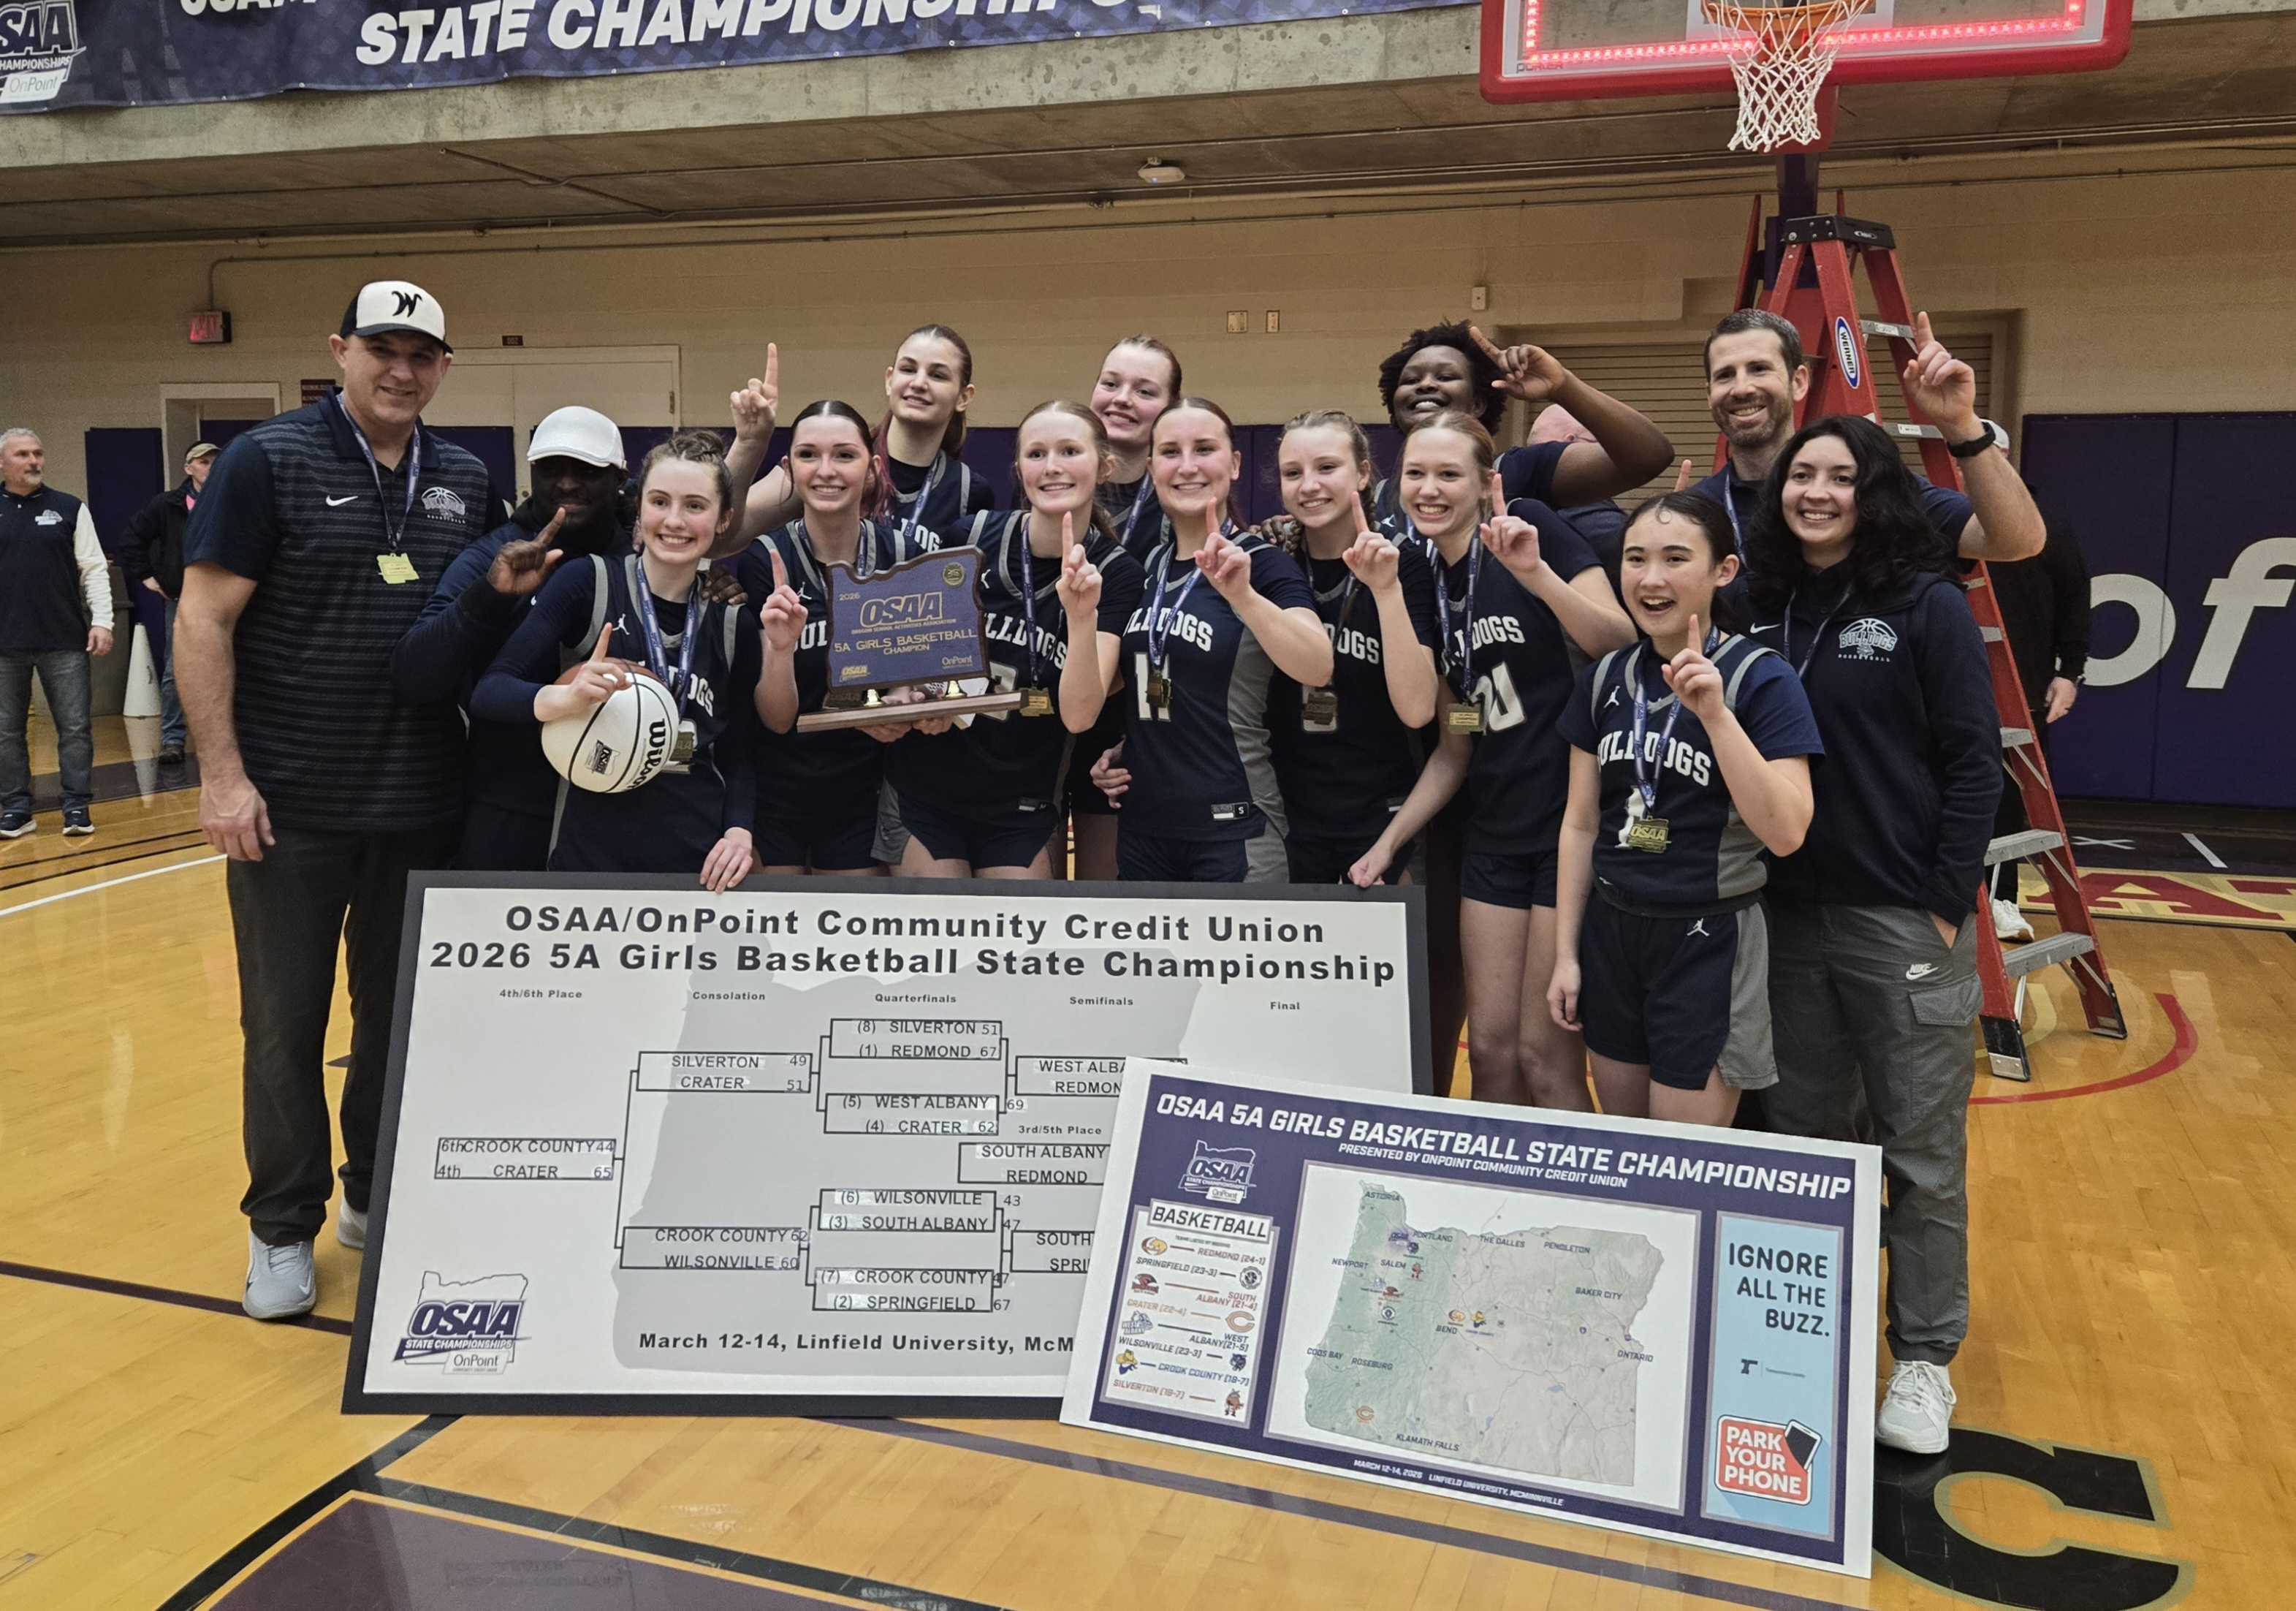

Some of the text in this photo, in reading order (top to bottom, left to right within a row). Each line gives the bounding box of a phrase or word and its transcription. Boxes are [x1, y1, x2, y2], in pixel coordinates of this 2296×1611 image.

[356, 0, 530, 65] STATE
[9, 77, 58, 92] OnPoint
[392, 290, 422, 317] W
[1839, 331, 1856, 375] WERNER
[860, 591, 943, 627] OSAA
[835, 629, 977, 652] 5A GIRLS BASKETBALL
[1840, 631, 1896, 651] BULLDOGS
[883, 645, 930, 655] CHAMPION
[942, 656, 973, 666] OnPoint
[1630, 825, 1667, 841] OSAA
[506, 906, 1324, 944] OSAA/OnPoint Community Credit Union
[430, 941, 1394, 988] 2026 5A Girls Basketball State Championship
[1910, 963, 1932, 973] NIKE
[499, 988, 582, 999] 4th/6th Place
[692, 990, 766, 1001] Consolation
[875, 992, 957, 1004] Quarterfinals
[1069, 996, 1134, 1007] Semifinals
[1269, 1001, 1301, 1011] Final
[857, 1020, 998, 1035] (8) SILVERTON 51
[859, 1043, 997, 1058] (1) REDMOND 67
[672, 1054, 807, 1069] SILVERTON 49
[1038, 1060, 1083, 1073] WEST
[680, 1076, 802, 1092] CRATER 51
[843, 1096, 1025, 1111] (5) WEST ALBANY 69
[865, 1119, 995, 1134] (4) CRATER 62
[1018, 1125, 1102, 1135] 3rd/5th Place
[464, 1140, 522, 1153] CROOK
[528, 1140, 595, 1153] COUNTY
[596, 1140, 615, 1153] 44
[981, 1145, 1106, 1159] SOUTH ALBANY
[1156, 1093, 1852, 1200] OSAA 5A GIRLS BASKETBALL STATE CHAMPIONSHIP
[437, 1164, 612, 1180] 4th CRATER 65
[1188, 1158, 1252, 1186] OSAA
[1338, 1143, 1628, 1189] PRESENTED BY ONPOINT COMMUNITY CREDIT UNION
[1006, 1170, 1088, 1184] REDMOND
[840, 1191, 1021, 1207] (6) WILSONVILLE 43
[1212, 1189, 1238, 1200] OnPoint
[1364, 1191, 1401, 1202] ASTORIA
[829, 1216, 1020, 1231] (3) SOUTH ALBANY 47
[1152, 1206, 1266, 1238] BASKETBALL
[655, 1228, 808, 1243] CROOK COUNTY 62
[1036, 1232, 1091, 1246] SOUTH
[1413, 1232, 1453, 1243] PORTLAND
[1479, 1235, 1526, 1248] THE DALLES
[1543, 1241, 1591, 1254] PENDLETON
[664, 1254, 798, 1270] WILSONVILLE 60
[1198, 1249, 1239, 1262] REDMOND
[1728, 1242, 1828, 1279] IGNORE
[1136, 1257, 1190, 1273] SPRINGFIELD
[1331, 1257, 1369, 1270] NEWPORT
[1380, 1259, 1407, 1270] SALEM
[821, 1270, 987, 1284] (7) CROOK COUNTY
[1228, 1292, 1257, 1303] SOUTH
[1575, 1286, 1623, 1300] BAKER CITY
[1736, 1275, 1826, 1308] ALL THE
[833, 1295, 1011, 1311] (2) SPRINGFIELD 67
[1127, 1298, 1160, 1311] CRATER
[1195, 1294, 1231, 1308] ALBANY
[410, 1302, 523, 1337] OSAA
[1765, 1308, 1830, 1337] BUZZ.
[1435, 1324, 1458, 1335] BEND
[405, 1339, 513, 1350] STATE CHAMPIONSHIPS
[639, 1333, 1074, 1354] March 12-14, Linfield University, McM
[1119, 1336, 1174, 1353] WILSONVILLE
[1225, 1333, 1250, 1343] WEST
[453, 1354, 498, 1367] OnPoint
[1307, 1346, 1344, 1360] COOS BAY
[1617, 1349, 1654, 1362] ONTARIO
[1351, 1357, 1394, 1371] ROSEBURG
[1157, 1363, 1187, 1375] CROOK
[1188, 1368, 1224, 1381] COUNTY
[1113, 1379, 1159, 1395] SILVERTON
[1396, 1433, 1460, 1452] KLAMATH FALLS
[1726, 1425, 1783, 1453] PARK
[1353, 1459, 1381, 1471] MARCH
[1725, 1444, 1786, 1473] YOUR
[1428, 1473, 1462, 1487] LINFIELD
[1724, 1464, 1802, 1496] PHONE
